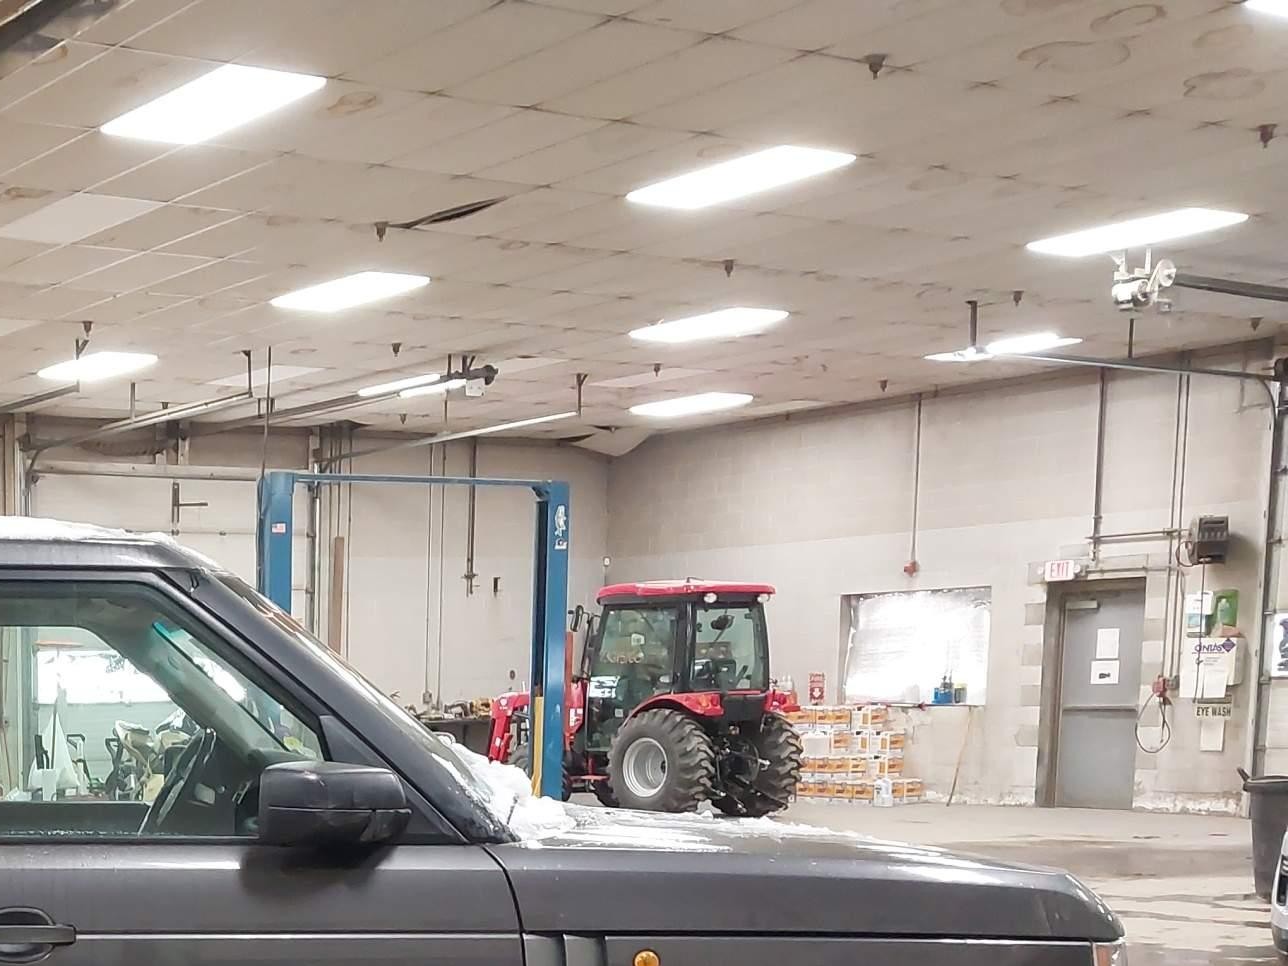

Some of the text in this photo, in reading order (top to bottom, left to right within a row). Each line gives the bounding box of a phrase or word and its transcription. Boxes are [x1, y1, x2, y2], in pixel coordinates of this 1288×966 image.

[1050, 562, 1069, 577] EXIT
[1196, 706, 1231, 716] EYE WASH
